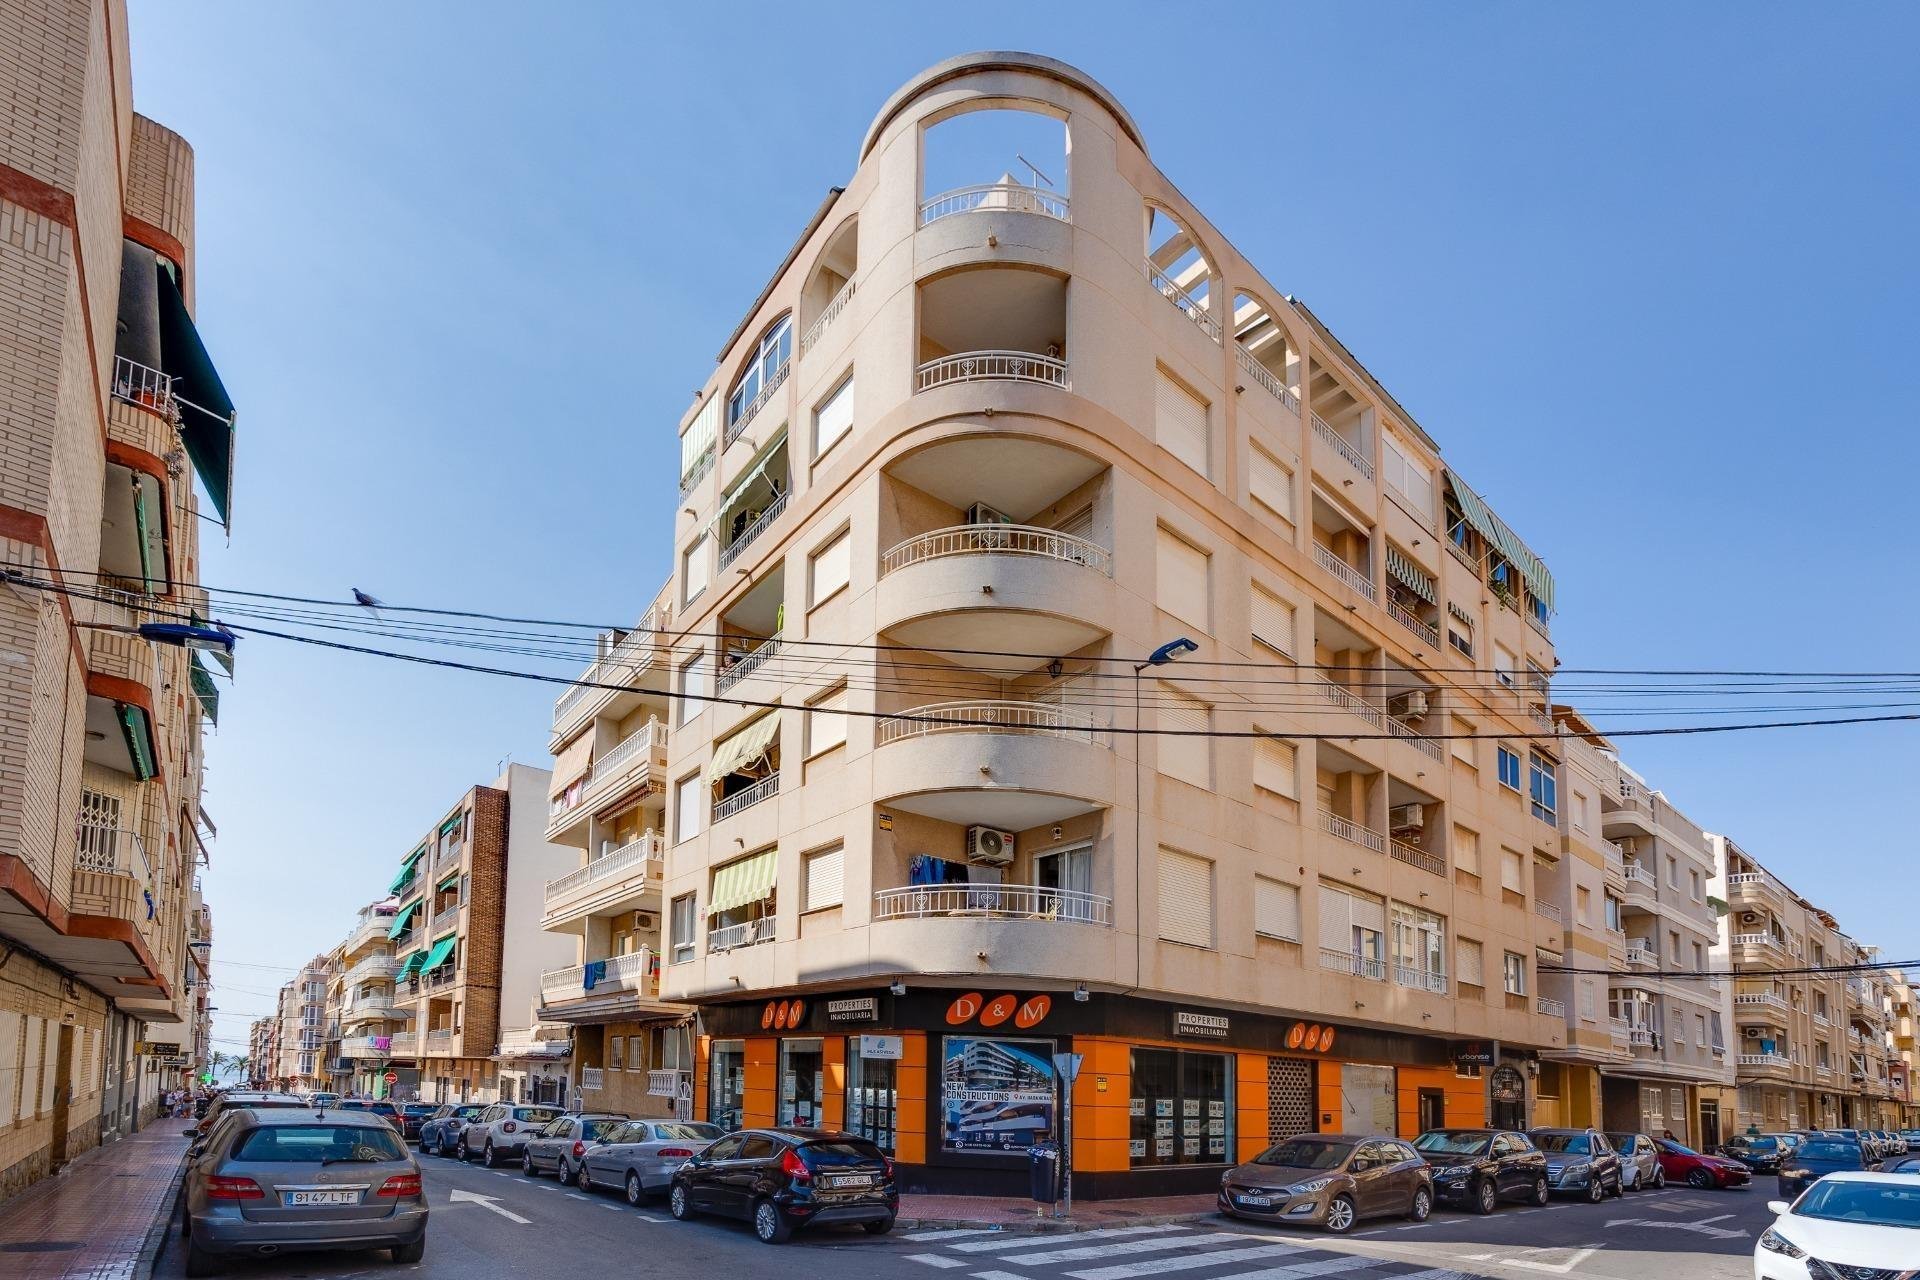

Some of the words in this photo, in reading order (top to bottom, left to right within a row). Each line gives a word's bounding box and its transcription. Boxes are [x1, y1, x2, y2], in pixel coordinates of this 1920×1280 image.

[829, 999, 872, 1011] PROPERTIES
[830, 1011, 872, 1021] INMOBILIARIA
[1181, 1014, 1228, 1028] PROPERTIES
[1180, 1026, 1228, 1037] INMOBILIARIA
[946, 1082, 965, 1091] NEW
[946, 1090, 1010, 1102] CONSTRUCTIONS
[295, 1193, 328, 1203] 9147
[331, 1192, 354, 1202] LTF
